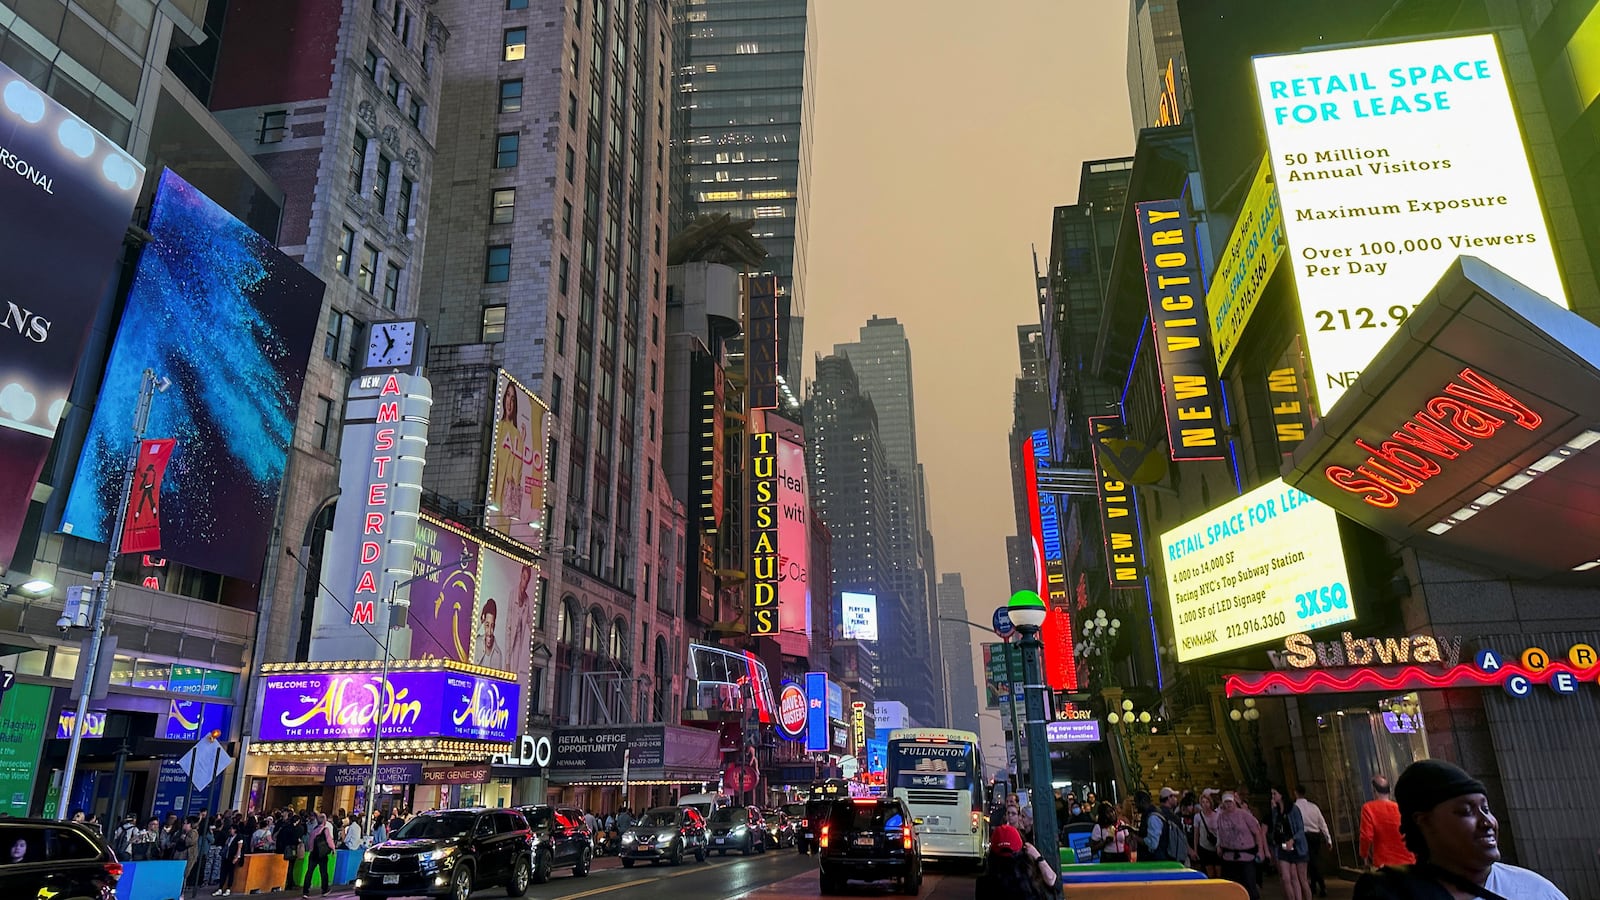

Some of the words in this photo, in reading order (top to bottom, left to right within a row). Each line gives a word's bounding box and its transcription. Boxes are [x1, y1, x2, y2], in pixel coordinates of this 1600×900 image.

[1269, 71, 1377, 100] RETAIL
[1388, 59, 1492, 88] SPACE
[1273, 102, 1341, 126] FOR
[1353, 90, 1452, 119] LEASE
[0, 146, 54, 194] RSONAL
[1284, 152, 1308, 166] 50
[1315, 146, 1391, 164] Million
[1288, 162, 1363, 182] Annual
[1367, 157, 1452, 176] Visitors
[1295, 202, 1401, 222] Maximum
[1406, 193, 1508, 215] Exposure
[1302, 245, 1353, 260] Over
[1359, 236, 1443, 256] 100,000
[1447, 231, 1537, 250] Viewers
[1147, 208, 1201, 353] VICTORY
[1229, 257, 1247, 301] SPACE
[1245, 230, 1259, 267] FOR
[1306, 262, 1341, 278] Per
[1347, 260, 1389, 276] Day
[1230, 252, 1267, 335] 212.916.3360
[1314, 303, 1422, 333] 212.9
[360, 376, 381, 389] NEW
[1326, 370, 1362, 389] NE
[1172, 374, 1217, 448] NEW
[502, 431, 543, 472] ALDO
[1325, 367, 1543, 508] Subway
[1096, 423, 1129, 519] VICY
[350, 374, 401, 626] AMSTERDAM
[415, 525, 438, 546] XACTLY
[753, 433, 775, 634] TUSSAUD'S
[1040, 503, 1063, 561] STUDIOS
[1168, 532, 1205, 562] RETAIL
[1206, 512, 1245, 546] SPACE
[1248, 498, 1278, 528] FOR
[1280, 488, 1317, 514] LEA
[430, 547, 443, 566] YOU
[1110, 532, 1138, 581] NEW
[1192, 564, 1200, 577] to
[1200, 556, 1225, 575] 14,000
[1225, 551, 1235, 564] SF
[1175, 586, 1199, 605] Facing
[1199, 579, 1222, 597] NYC's
[1222, 575, 1237, 589] Top
[1238, 565, 1270, 583] Subway
[1271, 550, 1305, 571] Station
[1198, 605, 1207, 619] SF
[1207, 604, 1216, 616] of
[1216, 598, 1233, 614] LED
[1233, 589, 1267, 608] Signage
[1295, 582, 1349, 620] 3XSQ
[1182, 629, 1219, 651] NEWMARK
[1225, 611, 1287, 640] 212.916.3360
[1285, 631, 1462, 670] Subway
[1482, 652, 1500, 670] A
[1527, 651, 1545, 669] Q
[1576, 648, 1593, 665] R
[268, 681, 308, 689] WELCOME
[309, 680, 321, 688] TO
[447, 678, 467, 688] WELCOME
[467, 681, 472, 689] TO
[1510, 676, 1528, 695] C
[1557, 674, 1574, 692] E
[280, 677, 422, 728] Aladdin
[452, 680, 509, 730] Aladdin
[781, 695, 798, 713] DAVE
[324, 727, 372, 735] BROADWAY
[381, 726, 413, 734] USICAL
[558, 735, 588, 745] RETAIL
[595, 734, 627, 743] OFFICE
[1072, 724, 1094, 732] worlds
[556, 759, 586, 767] NEWMARK
[557, 743, 618, 754] OPPORTUNITY
[900, 747, 965, 757] FULLINGTON
[160, 766, 186, 774] Intersectio
